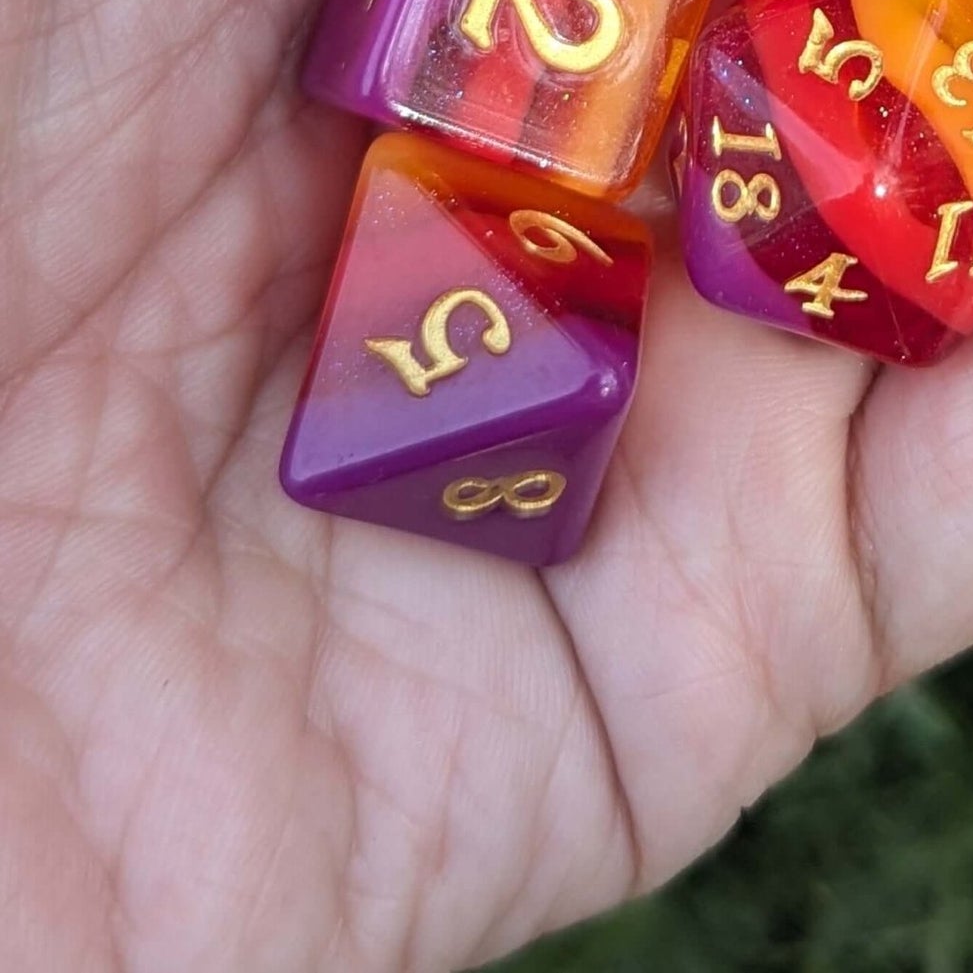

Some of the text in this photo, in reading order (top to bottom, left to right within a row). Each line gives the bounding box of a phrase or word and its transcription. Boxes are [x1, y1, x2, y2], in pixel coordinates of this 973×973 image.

[799, 7, 884, 102] 5
[711, 115, 782, 223] 18
[784, 251, 868, 319] 4
[363, 285, 512, 398] 5
[443, 469, 567, 516] 8
